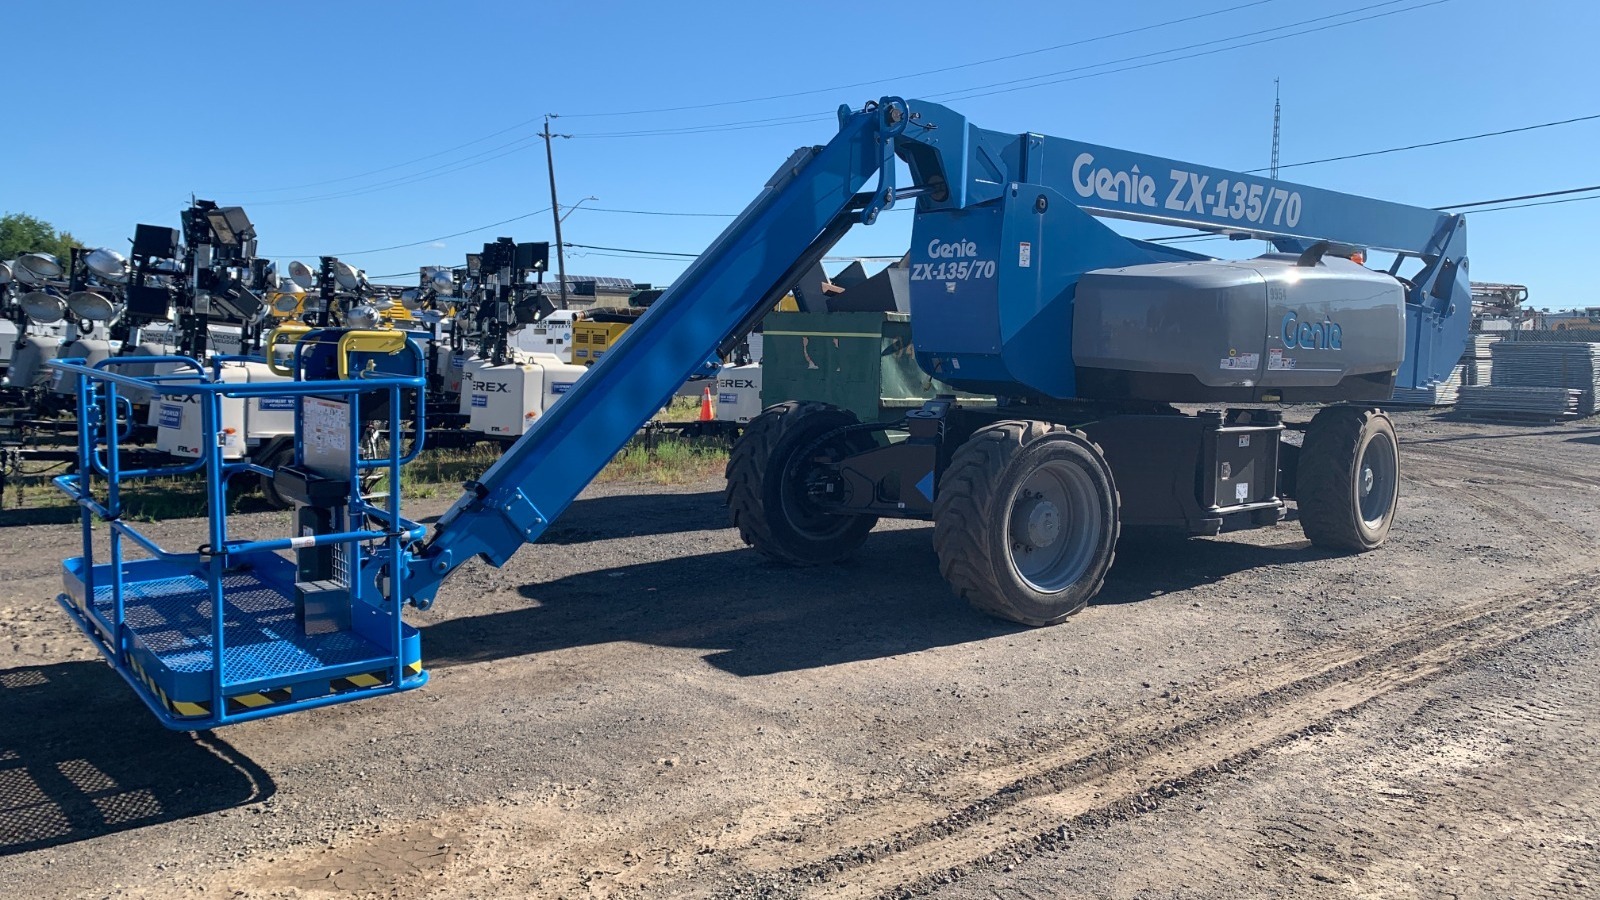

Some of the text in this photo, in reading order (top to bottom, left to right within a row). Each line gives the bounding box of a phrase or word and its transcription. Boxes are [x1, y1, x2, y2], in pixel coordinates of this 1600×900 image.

[1072, 152, 1302, 228] Genie ZX-135/70
[928, 238, 977, 259] Genie
[910, 260, 995, 280] ZX-135/70
[1281, 310, 1342, 350] Genie
[473, 381, 508, 392] EREX
[720, 379, 754, 388] EREX
[177, 445, 199, 454] RL4
